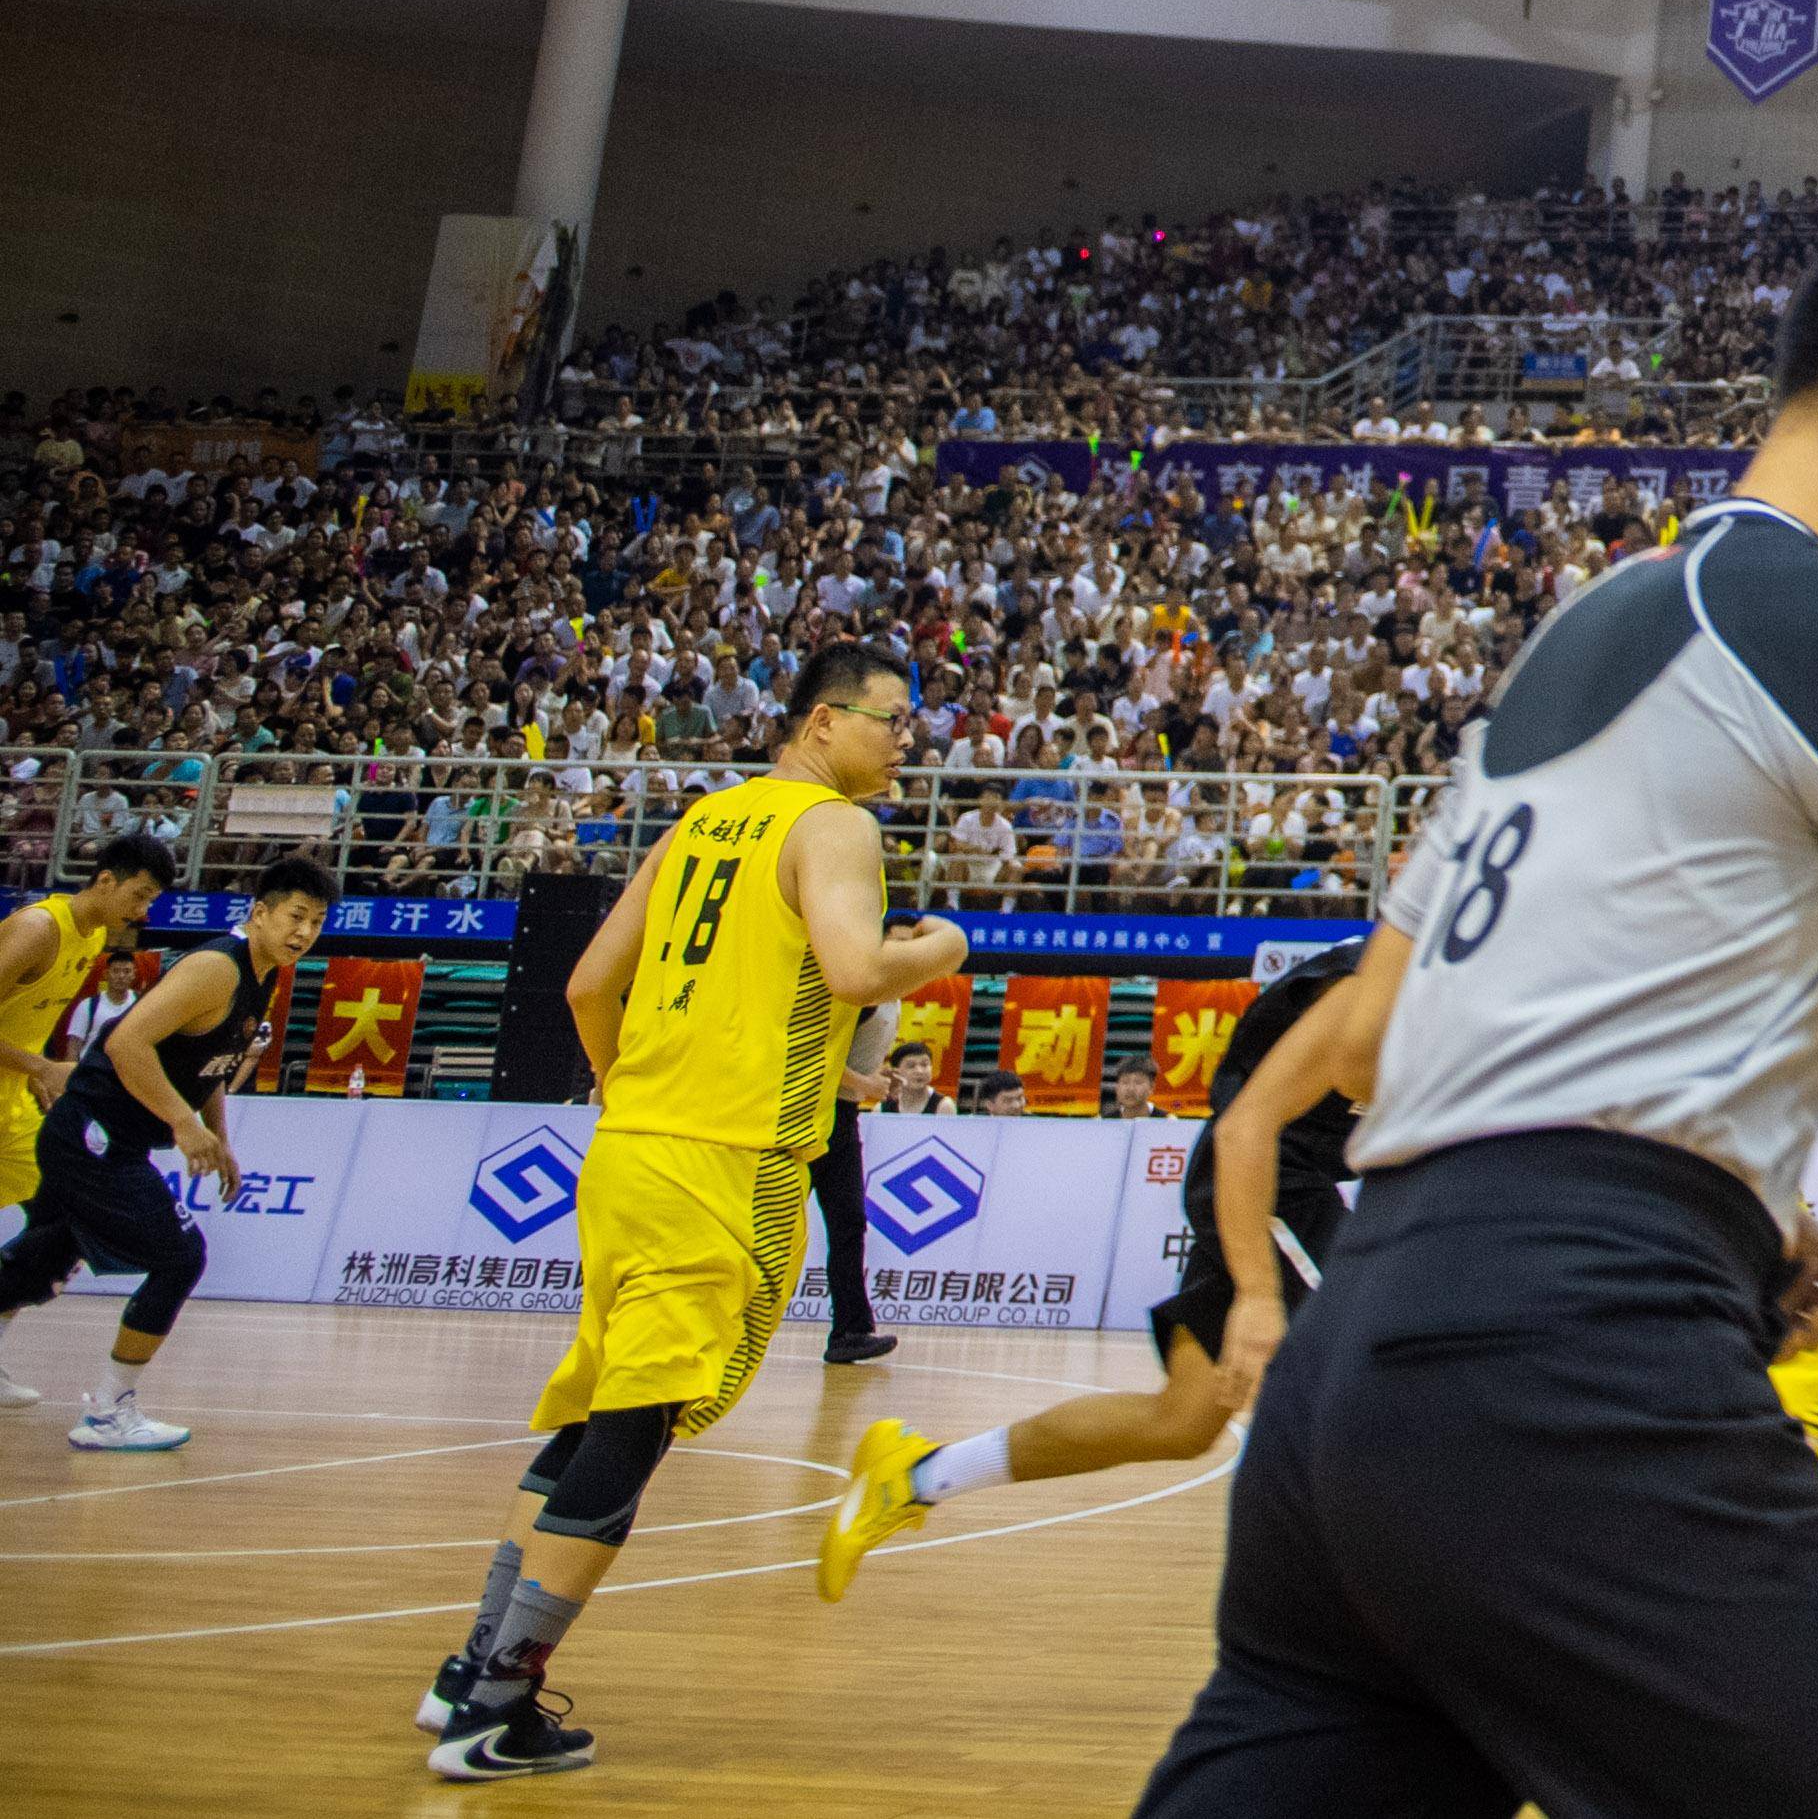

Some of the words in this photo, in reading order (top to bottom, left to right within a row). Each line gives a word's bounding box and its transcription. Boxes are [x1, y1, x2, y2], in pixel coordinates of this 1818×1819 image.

[660, 854, 742, 966] 18
[326, 987, 405, 1065] 大
[1014, 1004, 1093, 1084] 动
[224, 1171, 315, 1215] 宏工
[334, 1286, 428, 1306] ZHUZHOU
[433, 1290, 513, 1309] GECKOR
[792, 1267, 1076, 1305] 高集团有限公司
[918, 1304, 991, 1324] GROUP
